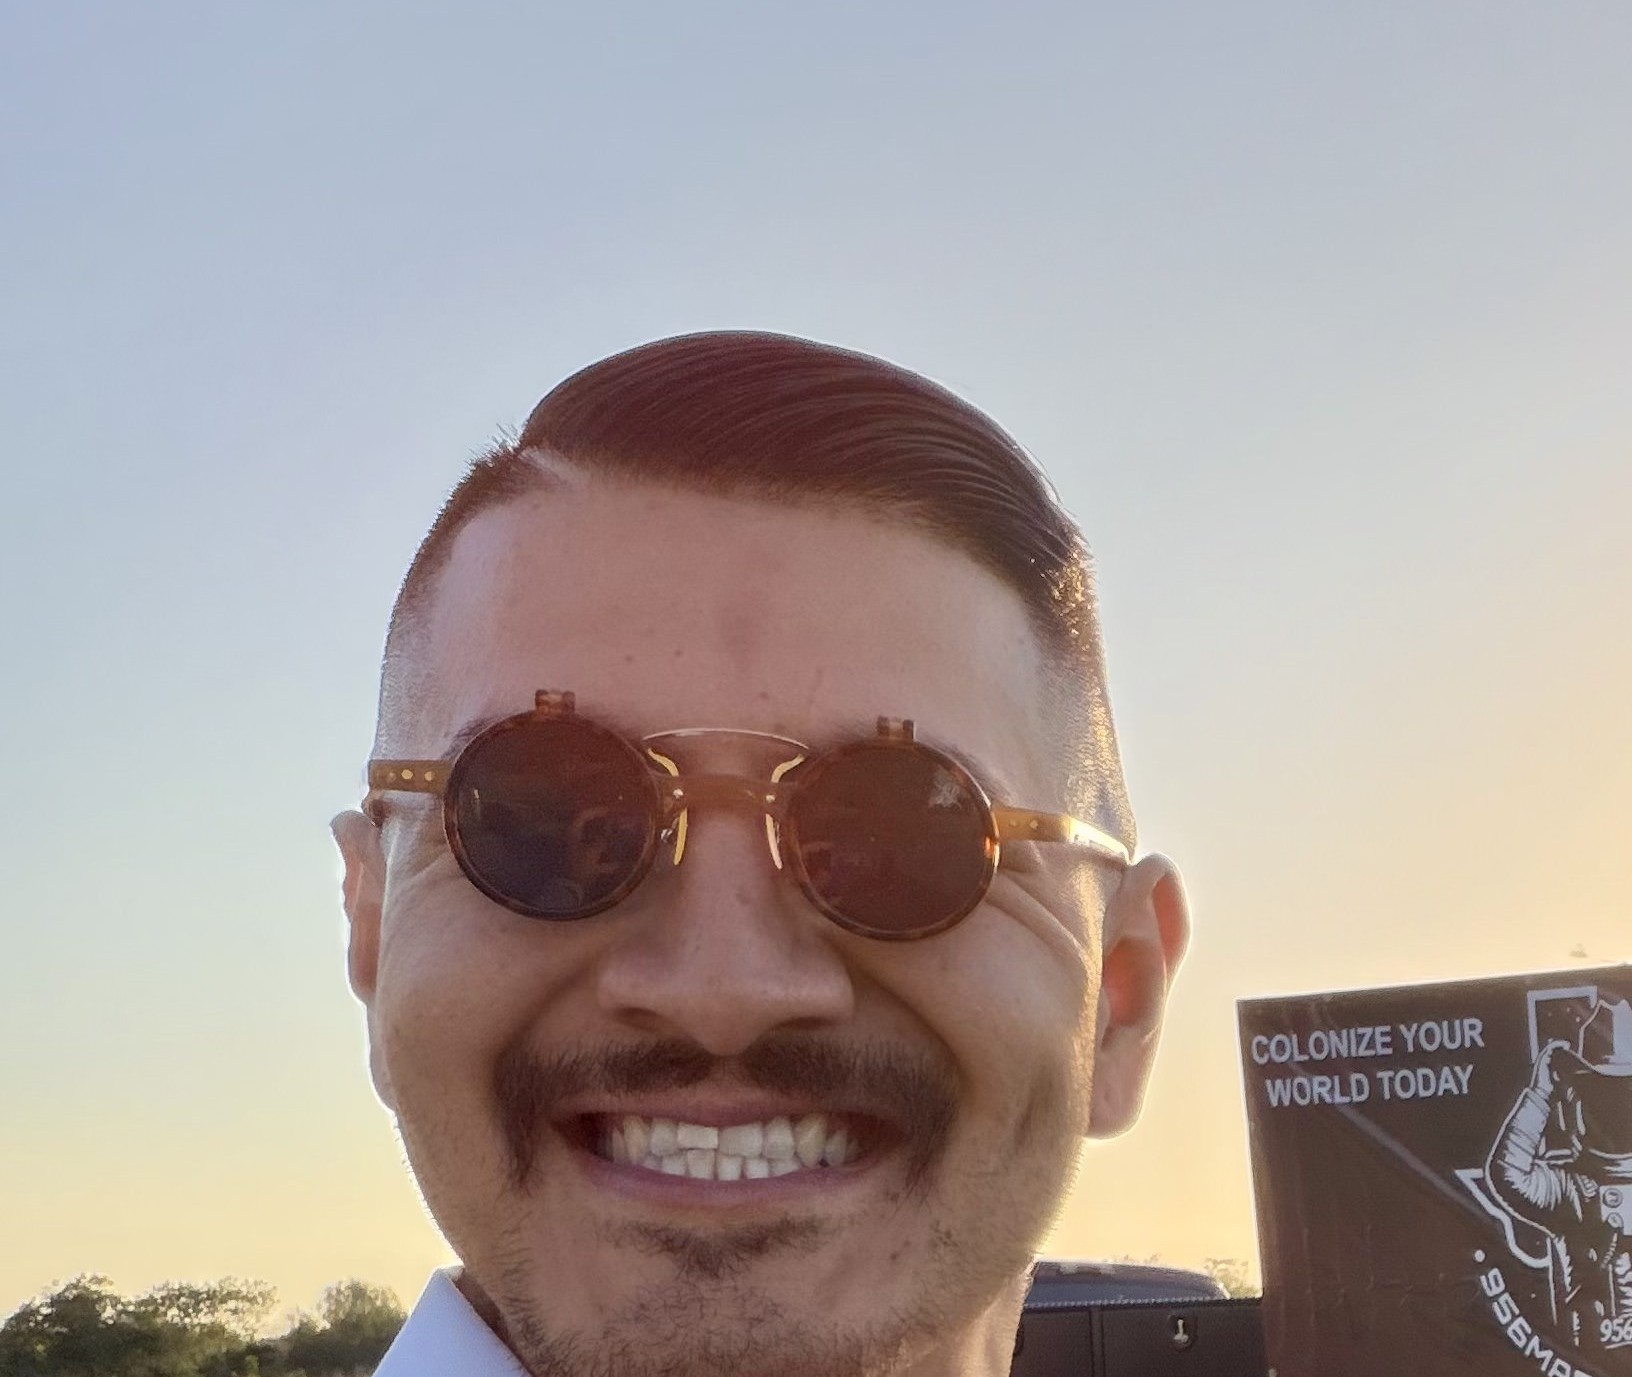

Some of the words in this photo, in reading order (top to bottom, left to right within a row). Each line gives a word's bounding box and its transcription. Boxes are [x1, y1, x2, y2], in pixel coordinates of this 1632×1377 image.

[1251, 1025, 1394, 1065] COLONIZE
[1400, 1017, 1485, 1053] YOUR
[1265, 1072, 1371, 1108] WORLD
[1376, 1064, 1474, 1100] TODAY
